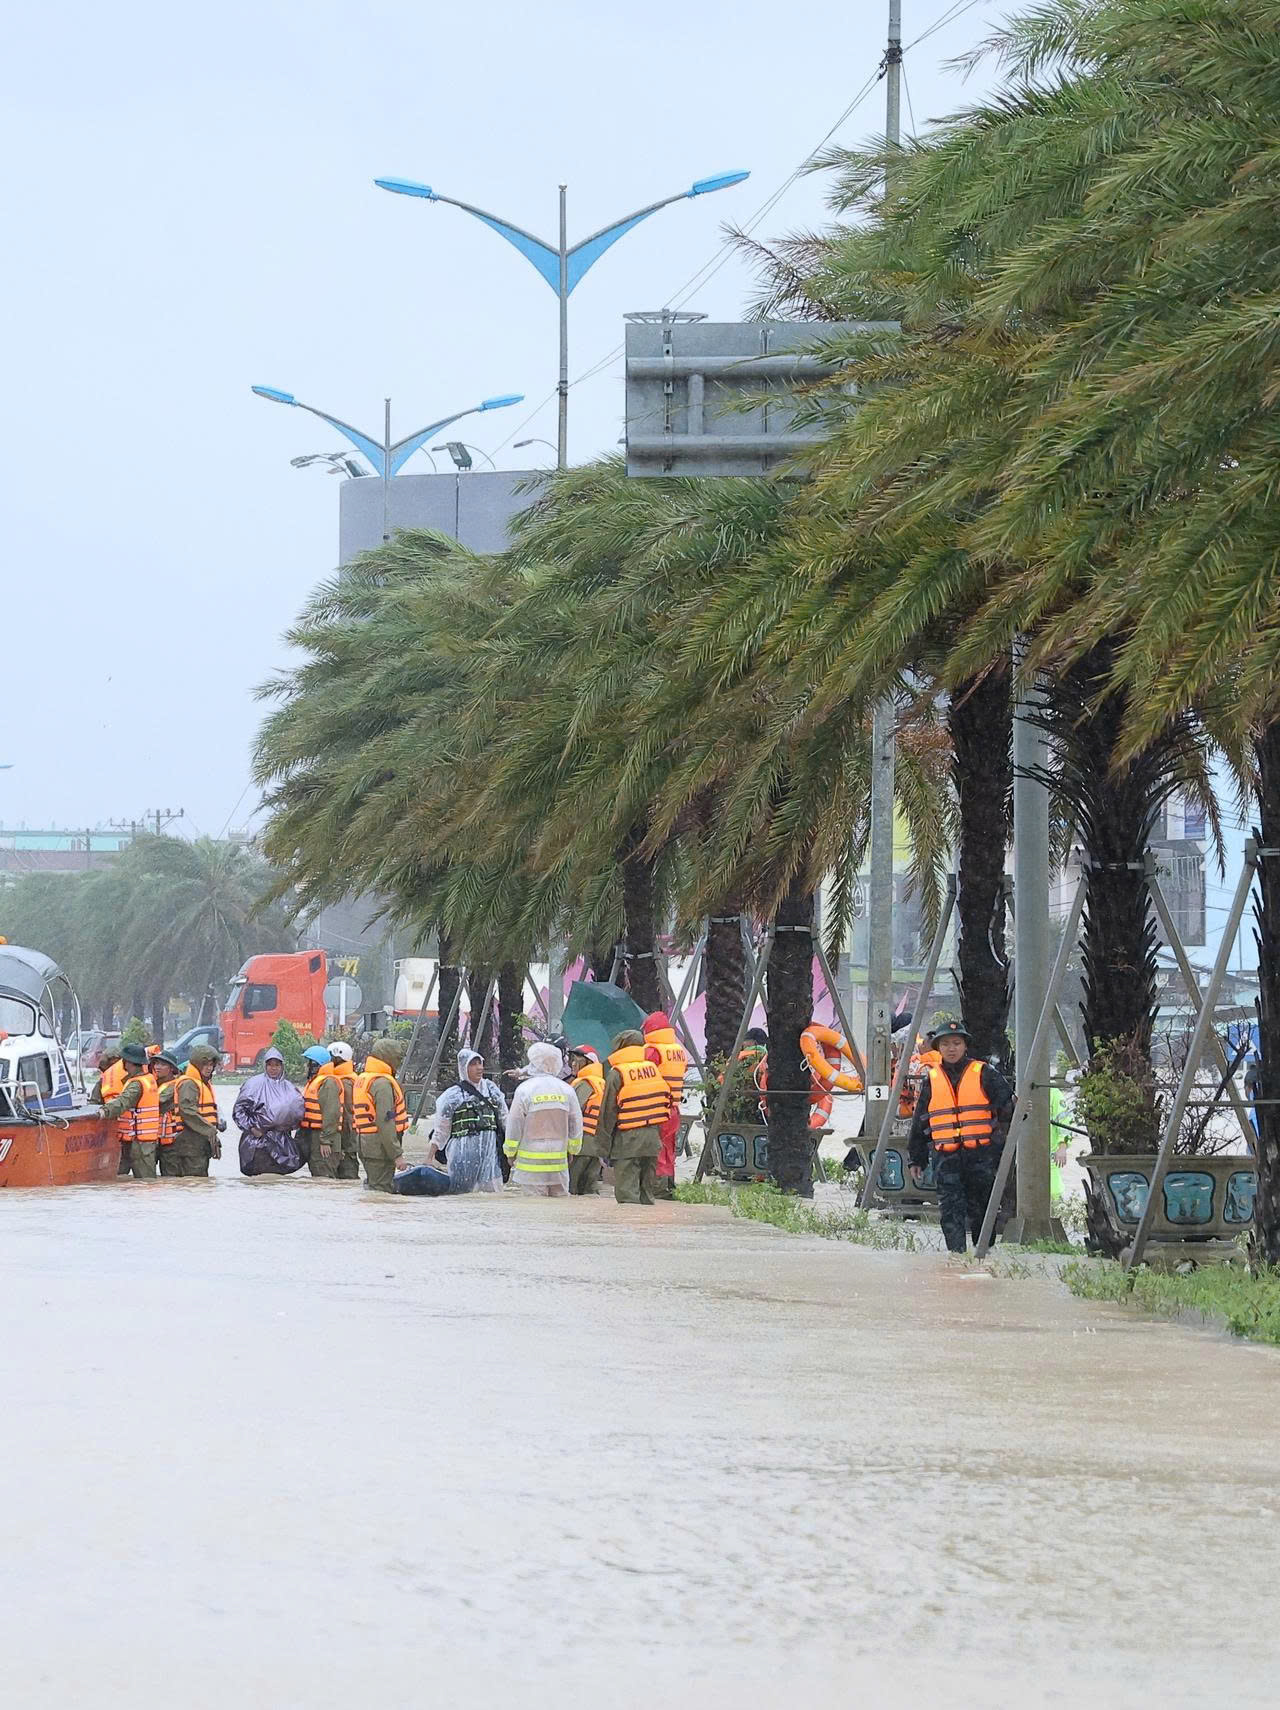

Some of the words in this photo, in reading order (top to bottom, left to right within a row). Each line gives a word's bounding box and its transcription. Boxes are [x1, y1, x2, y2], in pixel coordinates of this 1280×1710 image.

[666, 1049, 686, 1062] CAND
[629, 1066, 657, 1081] CAND
[875, 1087, 881, 1099] 3
